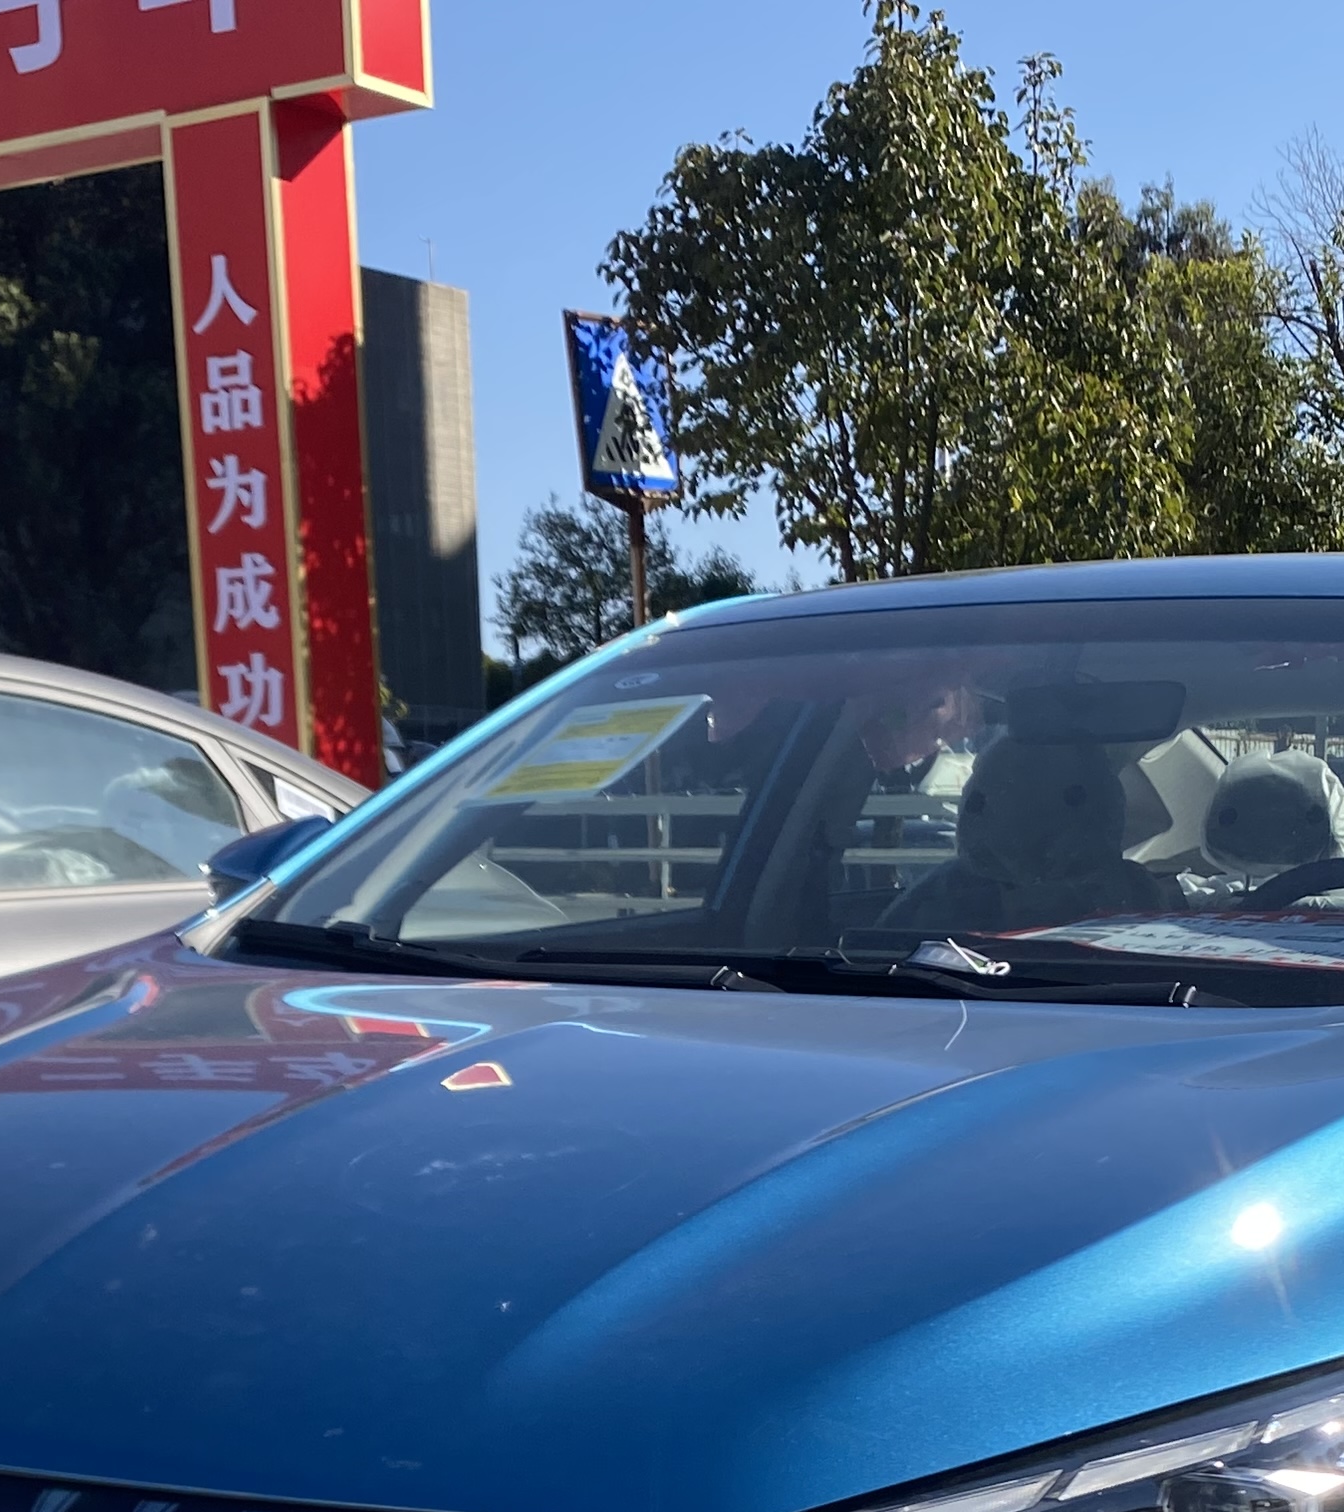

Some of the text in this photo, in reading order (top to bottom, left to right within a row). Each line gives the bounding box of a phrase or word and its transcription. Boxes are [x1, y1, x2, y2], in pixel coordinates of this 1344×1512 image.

[192, 253, 284, 728] 人品为成功
